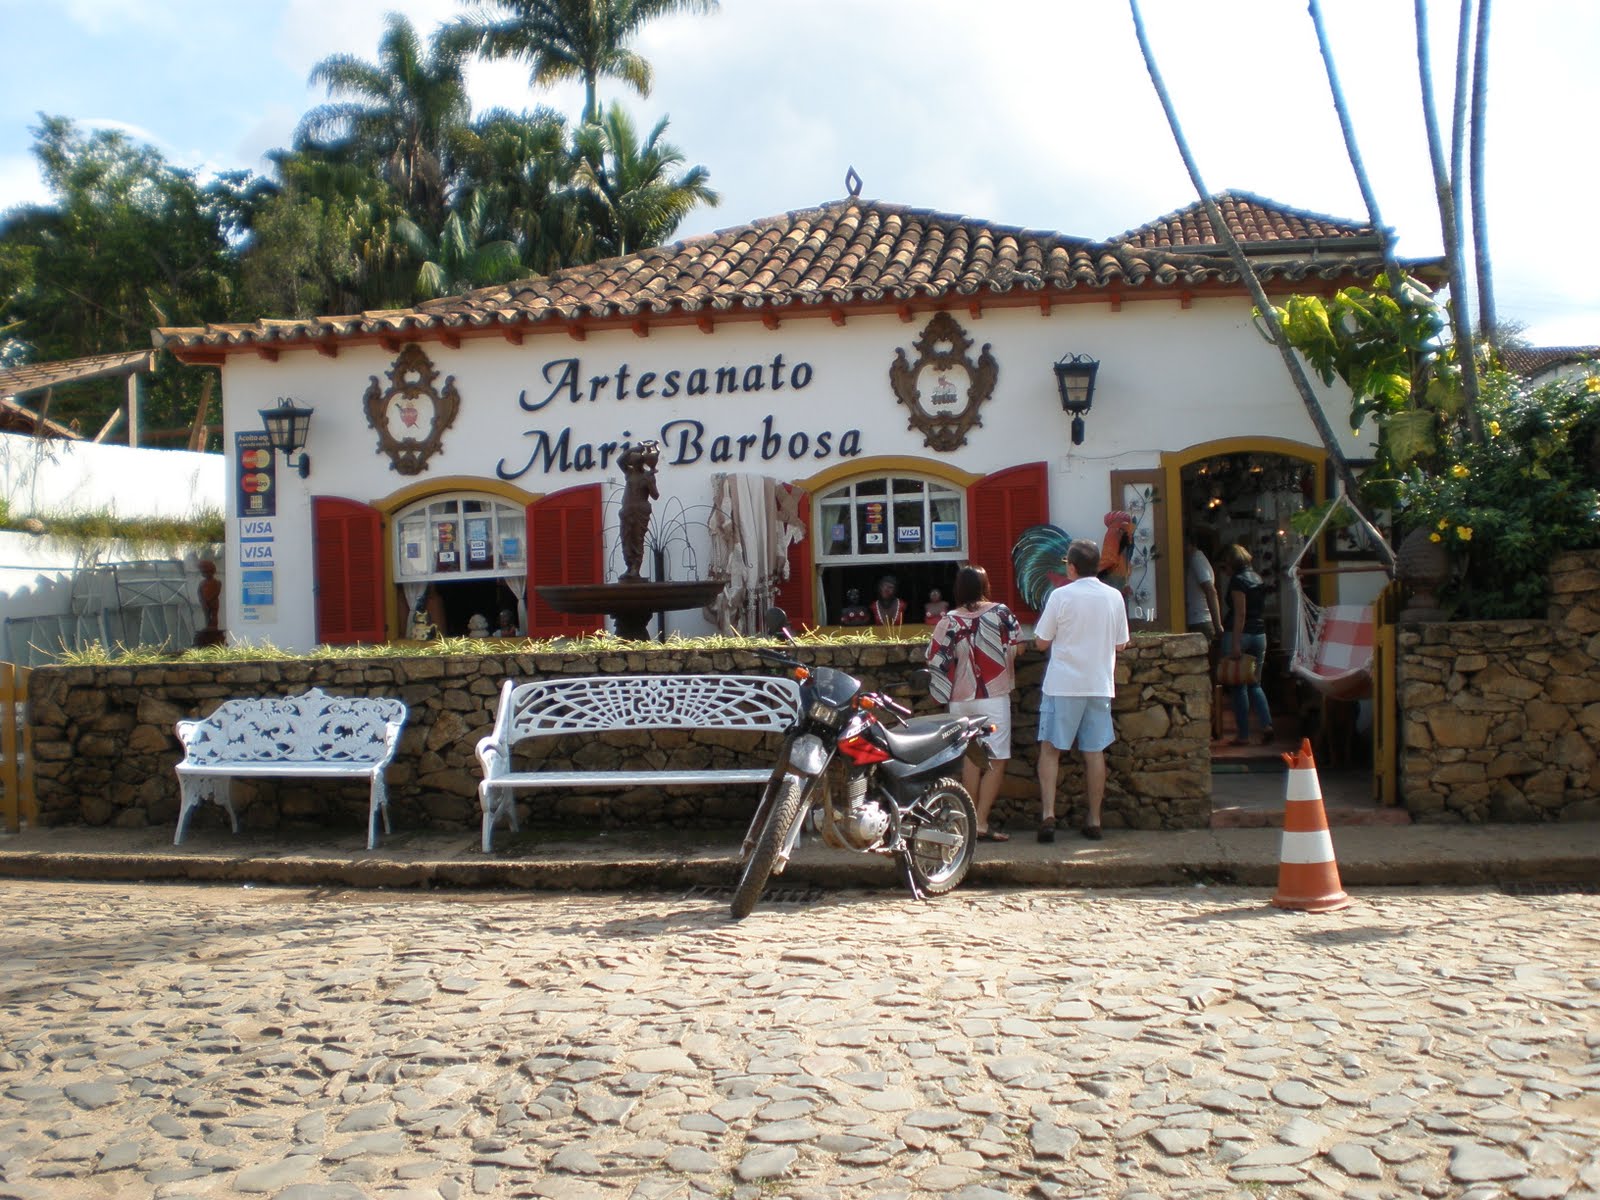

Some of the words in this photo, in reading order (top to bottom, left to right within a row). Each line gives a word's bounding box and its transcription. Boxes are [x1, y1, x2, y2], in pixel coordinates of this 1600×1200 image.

[519, 354, 813, 411] Artesanato
[496, 427, 632, 480] Mari
[661, 415, 862, 465] Barbosa
[245, 522, 273, 533] VISA
[245, 546, 273, 558] VISA
[942, 724, 962, 740] HONDA
